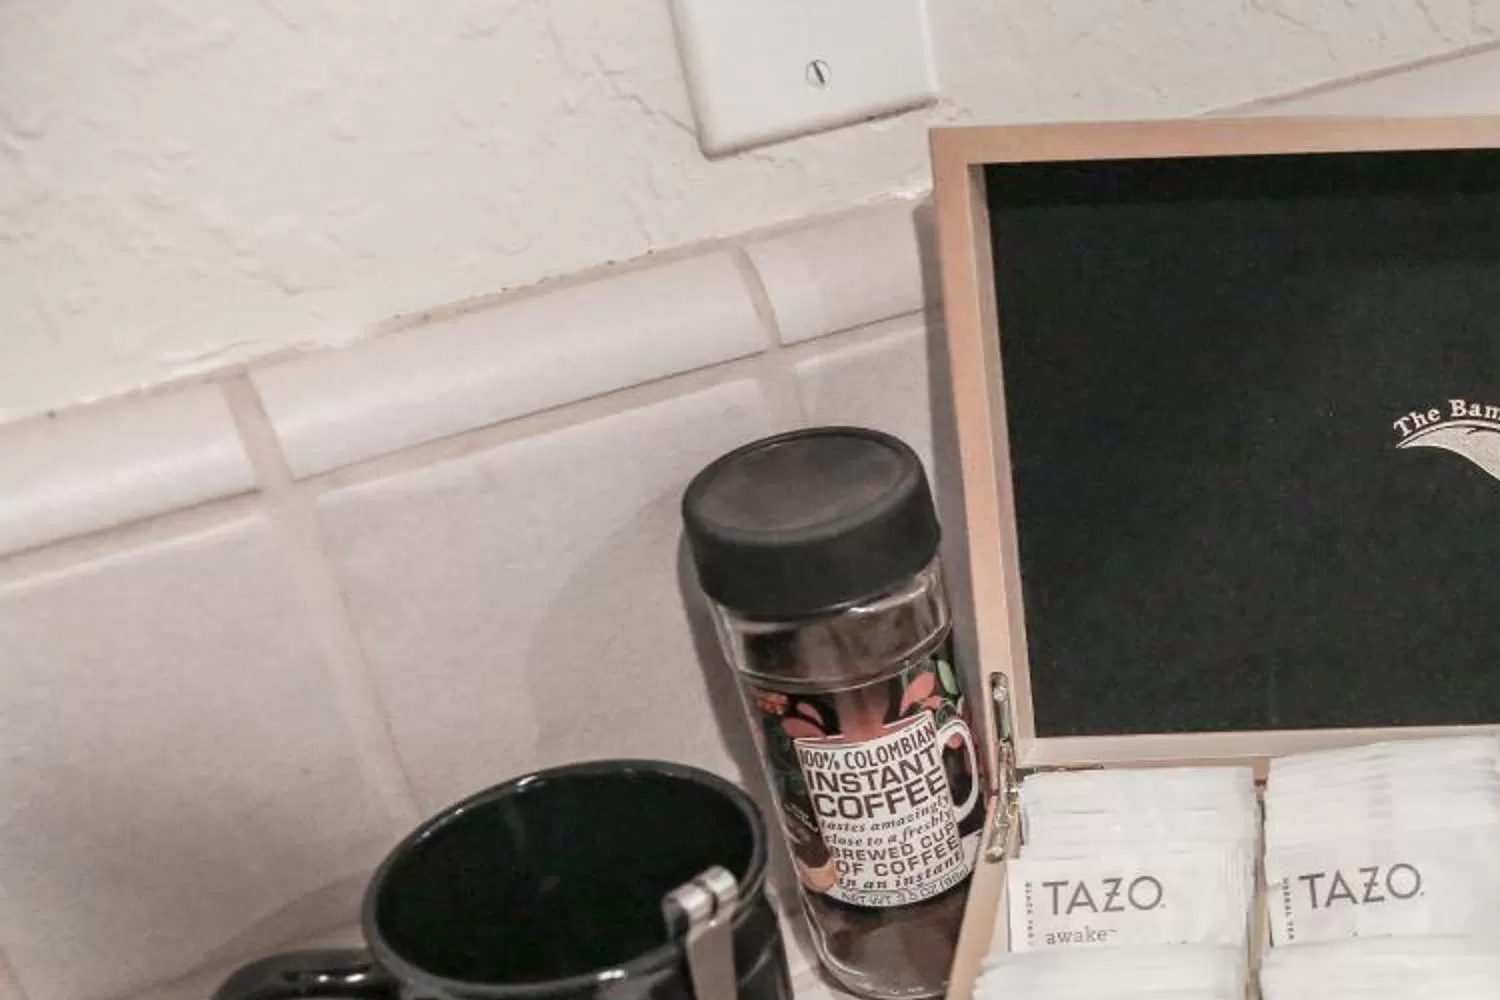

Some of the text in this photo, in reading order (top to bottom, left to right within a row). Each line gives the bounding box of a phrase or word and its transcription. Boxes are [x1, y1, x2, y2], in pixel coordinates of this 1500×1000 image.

[1393, 407, 1441, 437] The
[801, 722, 937, 770] 100% COLOMBIAN
[807, 743, 936, 793] INSTANT
[813, 767, 946, 819] COFFEE
[821, 819, 866, 833] tastes
[825, 809, 953, 846] close to a freshly
[828, 822, 956, 862] BREWED CUP
[835, 860, 865, 877] OF
[873, 836, 960, 877] COFFEE
[863, 878, 888, 889] an
[1042, 875, 1163, 916] TAZO
[1298, 863, 1421, 909] TAZO
[1046, 926, 1107, 945] awake
